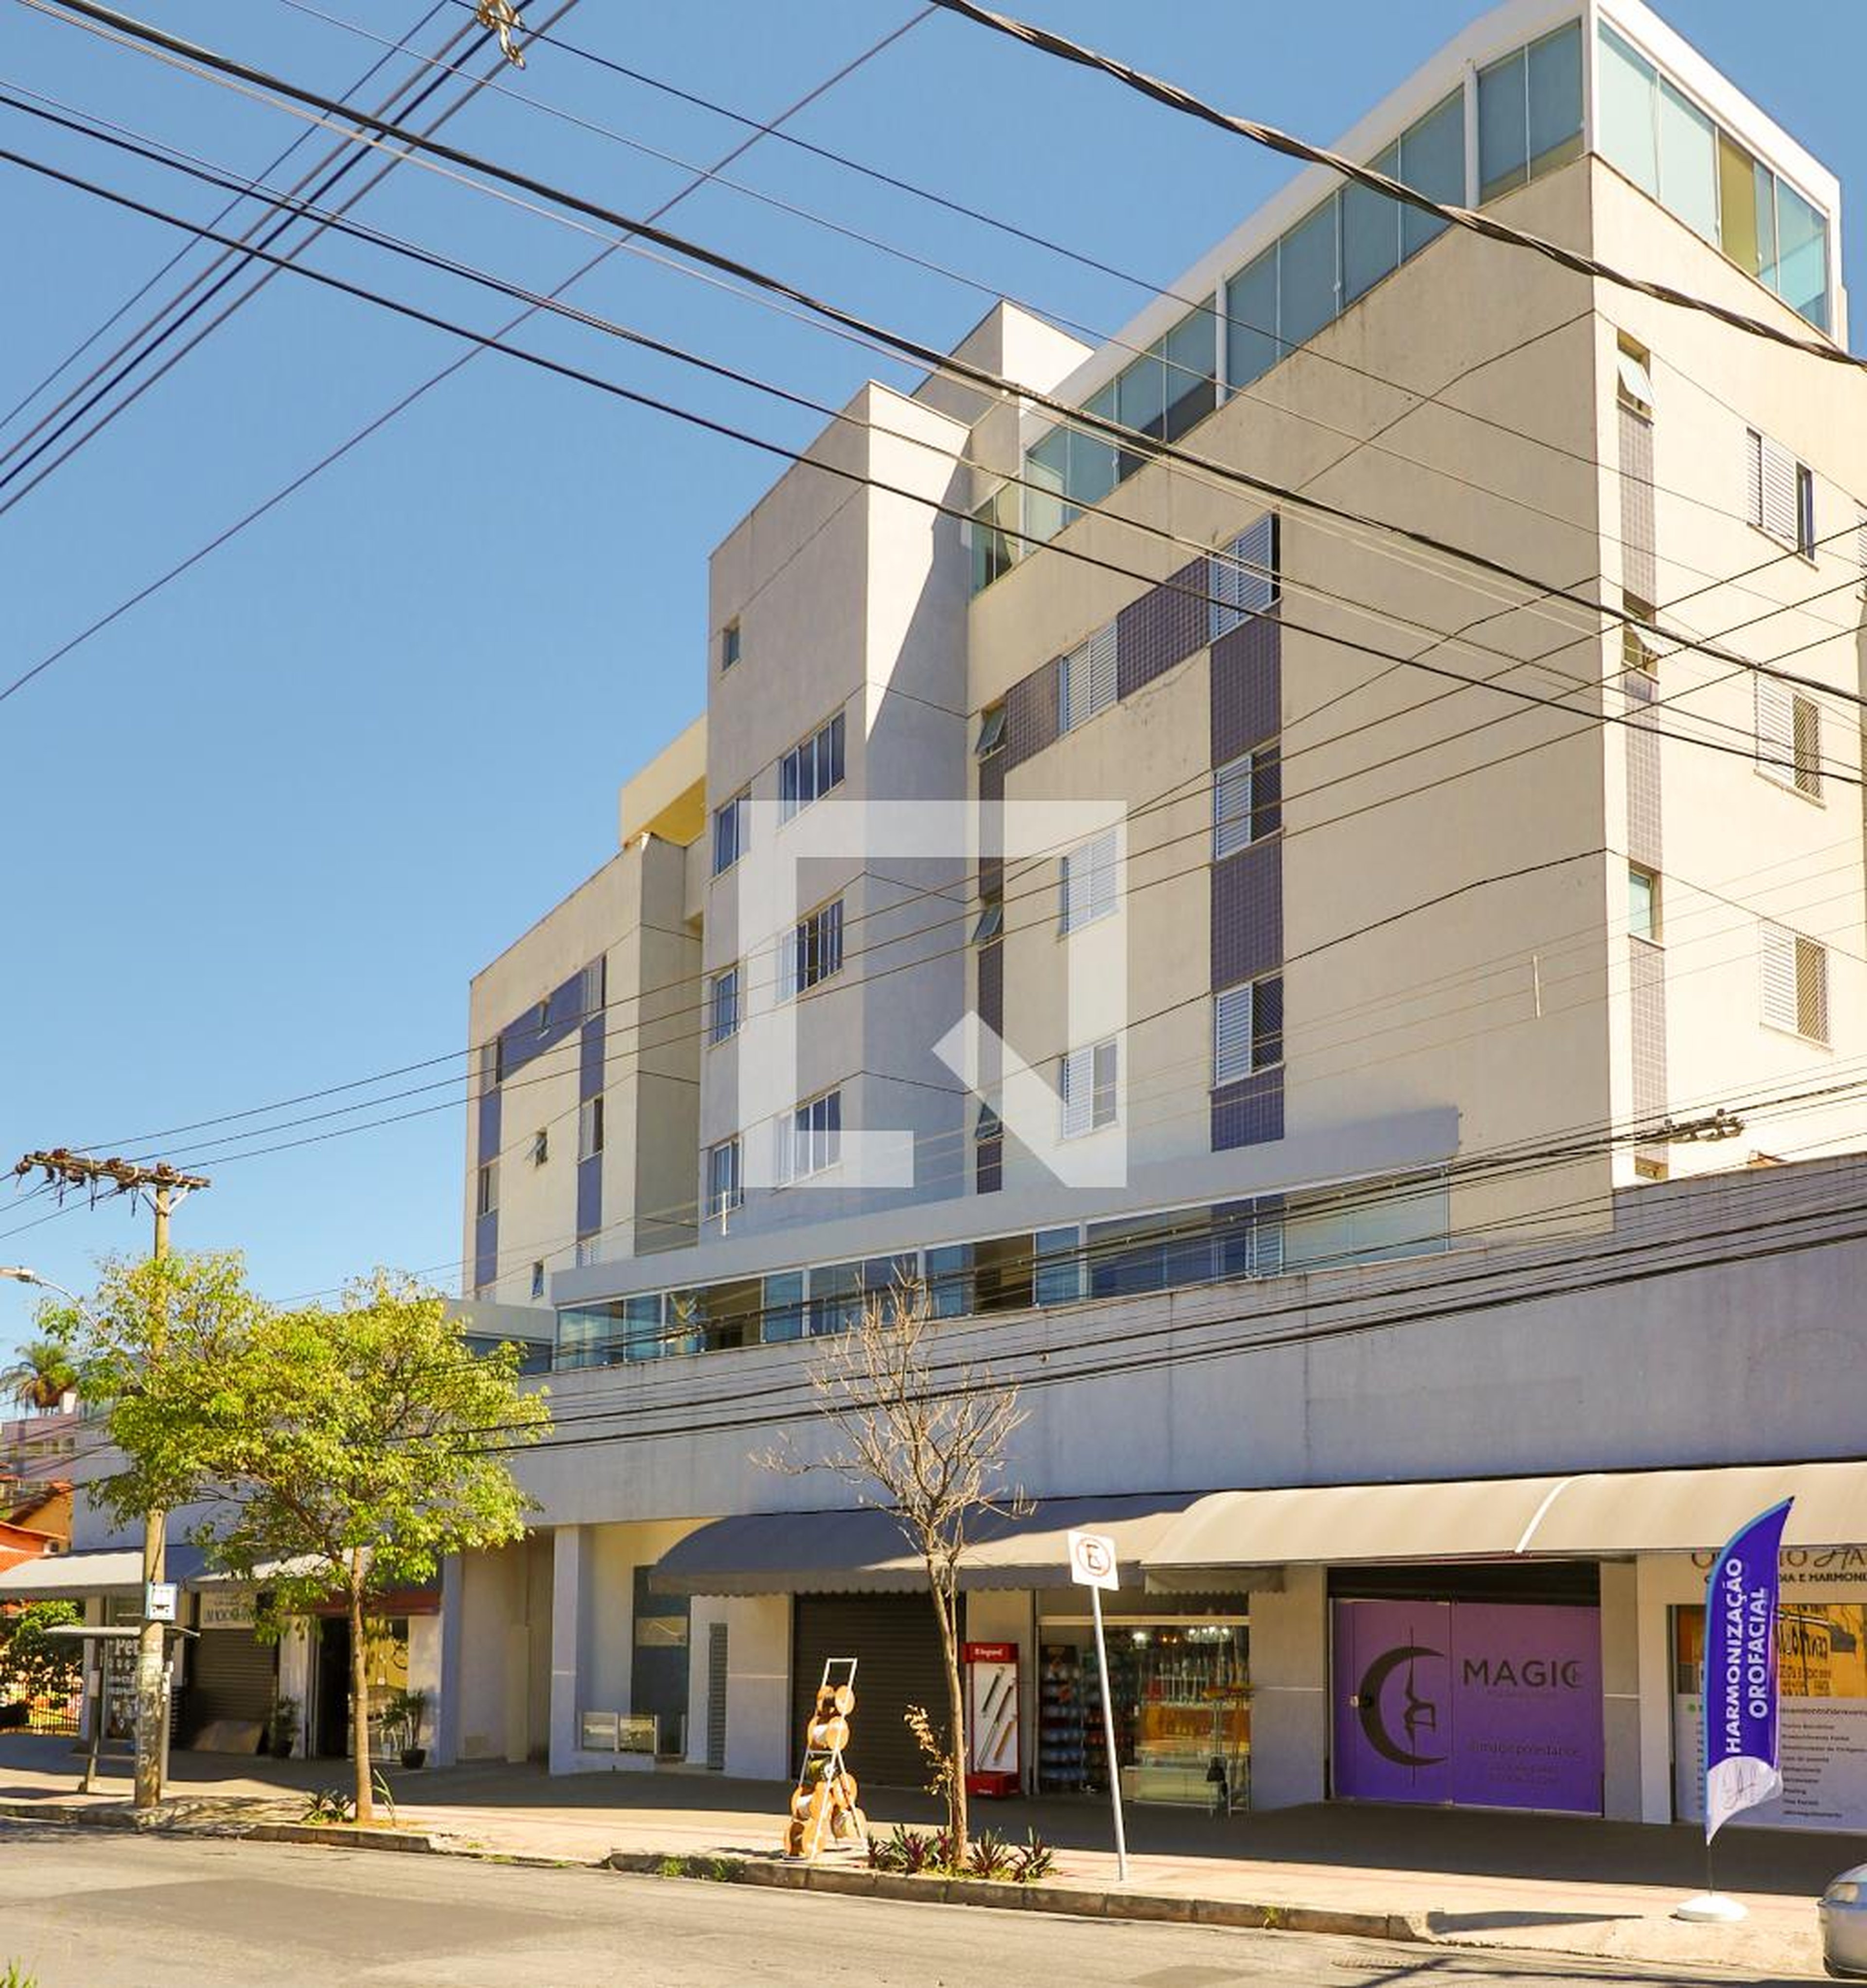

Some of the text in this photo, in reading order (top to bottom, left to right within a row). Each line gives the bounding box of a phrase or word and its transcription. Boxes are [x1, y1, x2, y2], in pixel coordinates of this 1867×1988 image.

[1463, 1659, 1584, 1689] MAGIC
[1723, 1558, 1747, 1753] HARMONIZAÇÃO
[1748, 1587, 1769, 1719] OROFACIAL
